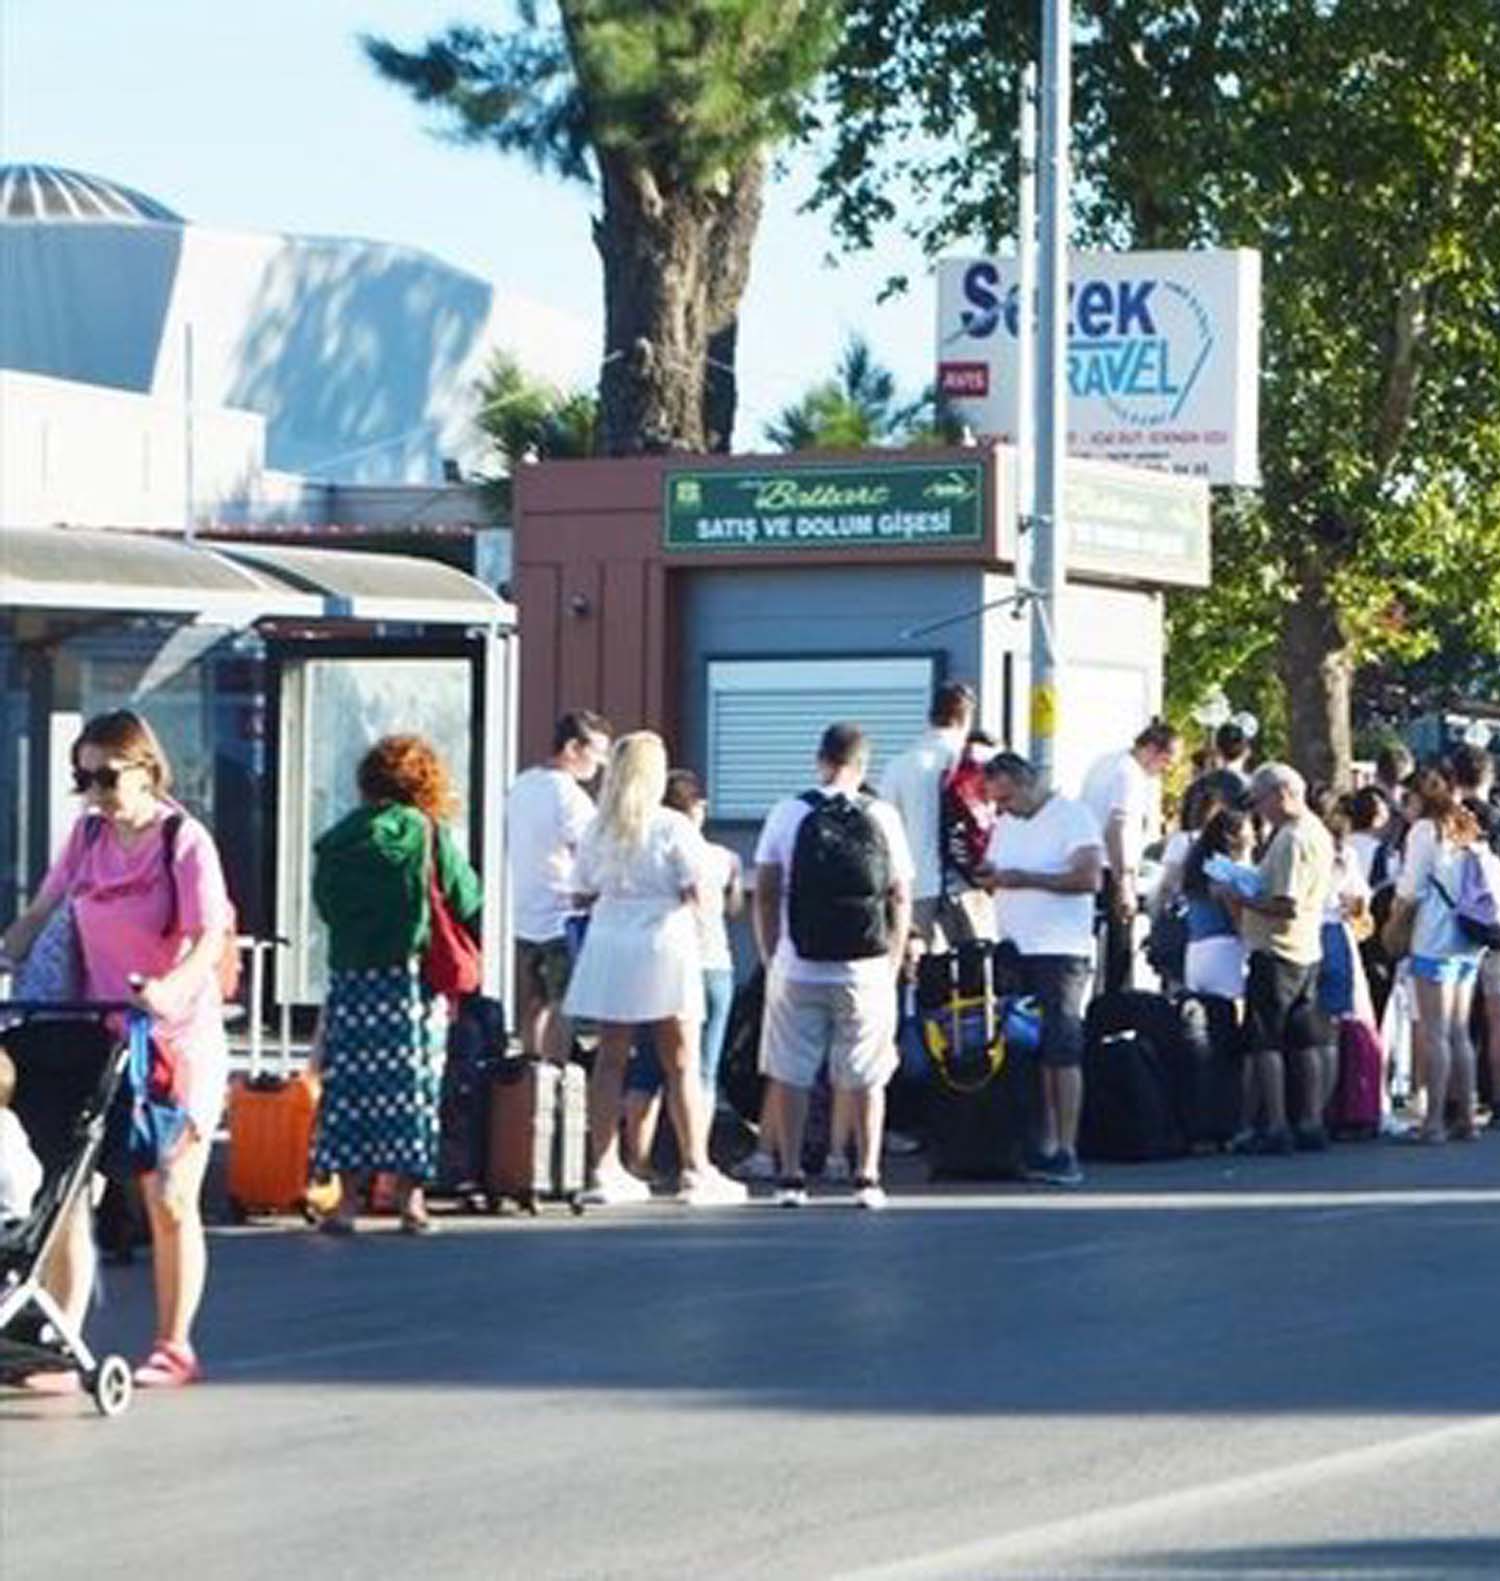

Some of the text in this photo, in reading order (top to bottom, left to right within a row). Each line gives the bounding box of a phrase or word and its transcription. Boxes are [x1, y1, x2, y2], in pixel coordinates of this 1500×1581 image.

[961, 262, 1157, 338] Seek
[697, 507, 951, 543] SATIŞ VE DOLUM GİŞESİ
